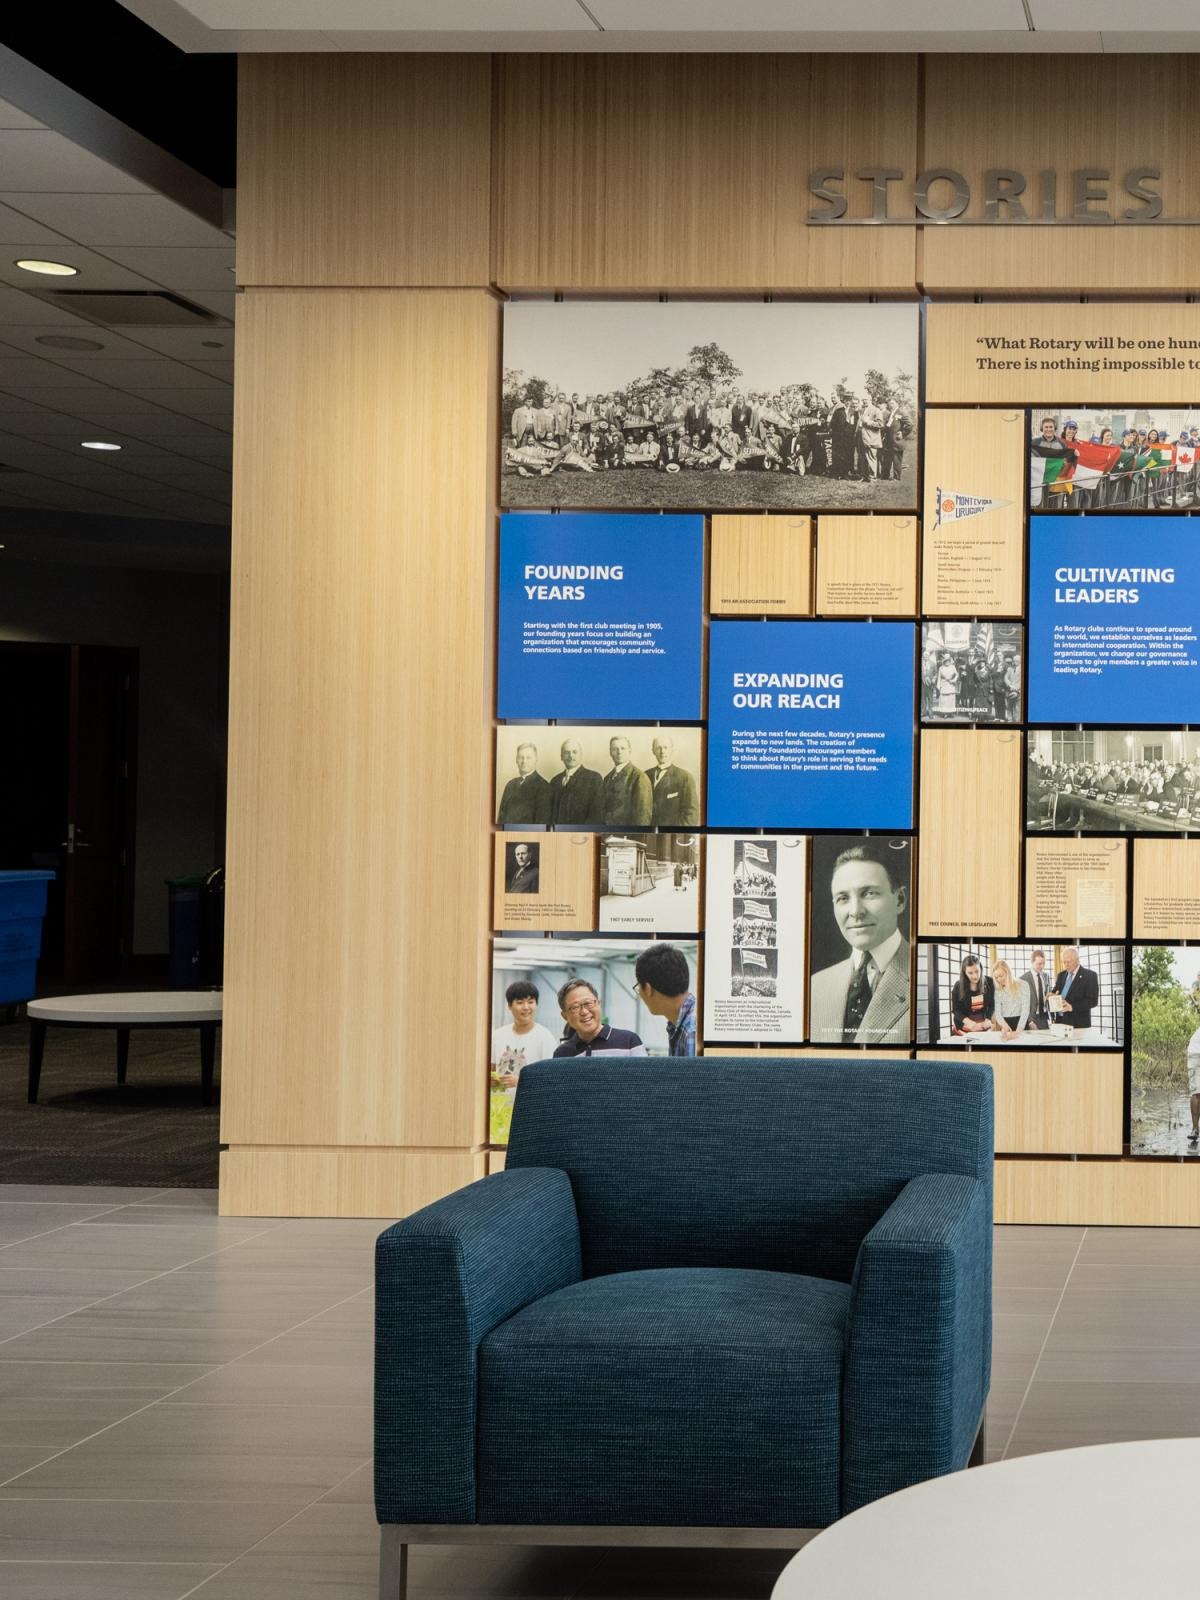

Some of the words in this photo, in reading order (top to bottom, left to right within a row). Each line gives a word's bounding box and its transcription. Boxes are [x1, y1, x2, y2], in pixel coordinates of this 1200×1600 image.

[807, 167, 1162, 220] STORIES
[976, 337, 1026, 349] “What
[1029, 338, 1082, 351] Rotary
[1084, 337, 1114, 349] will
[1117, 337, 1134, 349] be
[1138, 340, 1165, 349] one
[976, 358, 1021, 369] There
[1024, 358, 1037, 369] is
[1040, 357, 1100, 372] nothing
[1103, 357, 1185, 372] impossible
[956, 507, 984, 518] URUGUAY
[525, 565, 623, 580] FOUNDING
[1056, 568, 1174, 583] CULTIVATING
[524, 585, 585, 600] YEARS
[1056, 588, 1139, 603] LEADERS
[524, 622, 550, 630] Starting
[609, 623, 636, 631] meeting
[1064, 625, 1086, 634] Rotary
[1144, 626, 1167, 634] spread
[536, 630, 566, 638] founding
[615, 631, 642, 639] building
[523, 638, 565, 647] organization
[619, 639, 656, 647] community
[593, 647, 627, 655] friendship
[734, 673, 843, 688] EXPANDING
[733, 694, 772, 708] OUR
[778, 694, 840, 708] REACH
[732, 738, 760, 747] expands
